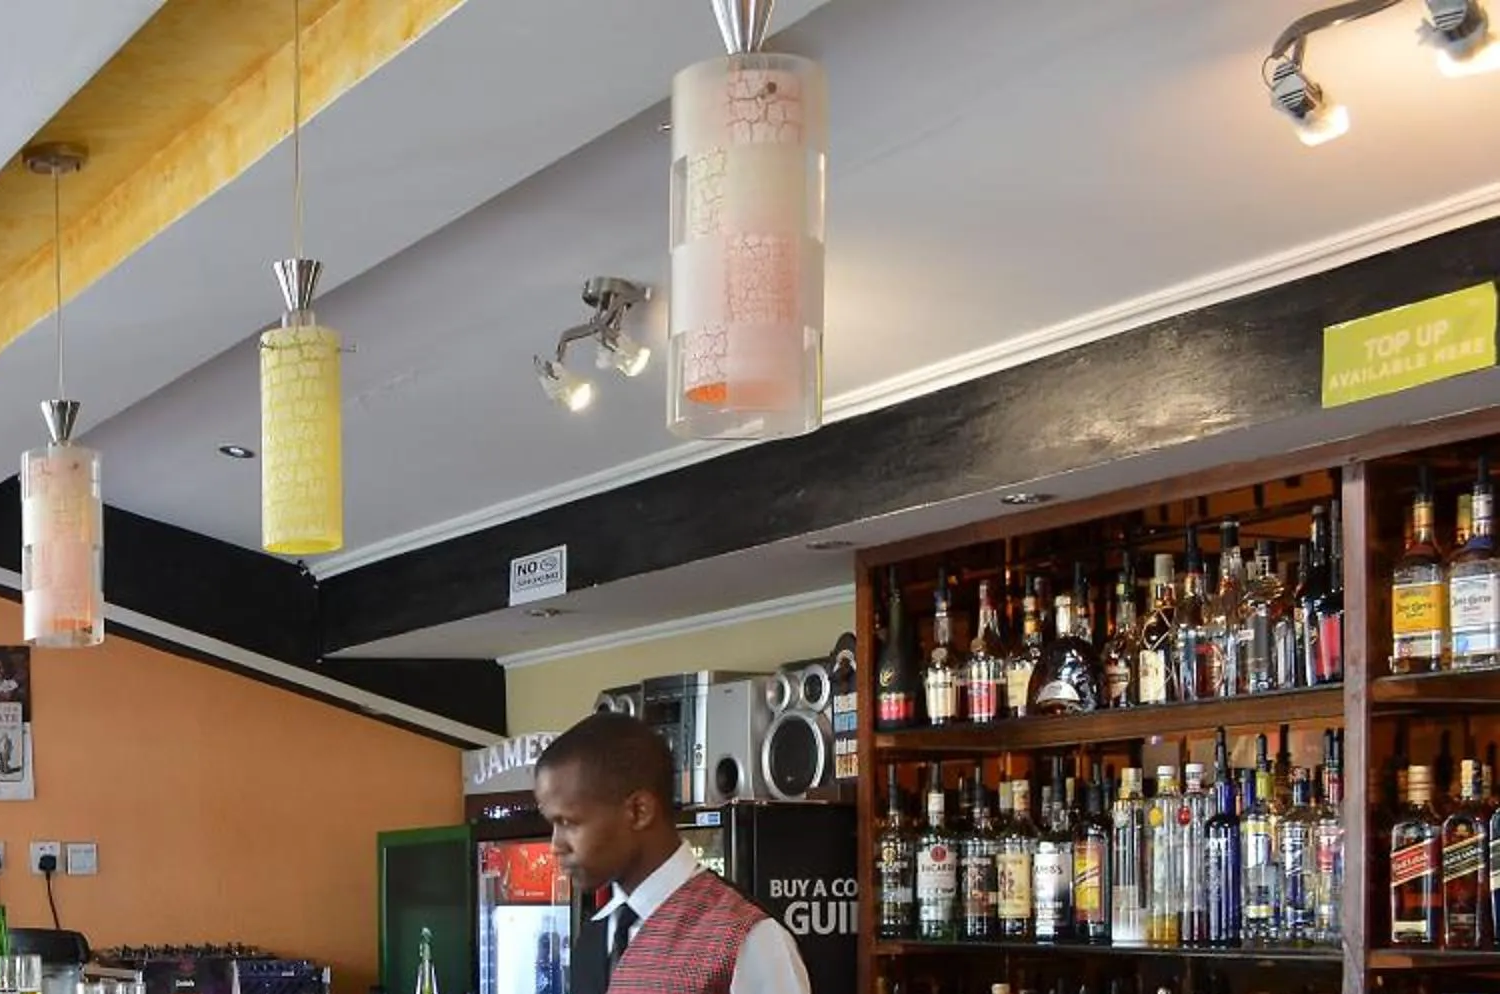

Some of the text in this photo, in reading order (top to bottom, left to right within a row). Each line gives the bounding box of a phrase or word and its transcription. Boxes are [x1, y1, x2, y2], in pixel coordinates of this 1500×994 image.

[1365, 319, 1449, 360] TOP UP
[1329, 353, 1428, 390] AVAILABLE
[518, 561, 537, 576] NO
[770, 879, 810, 897] BUY
[813, 879, 828, 897] A
